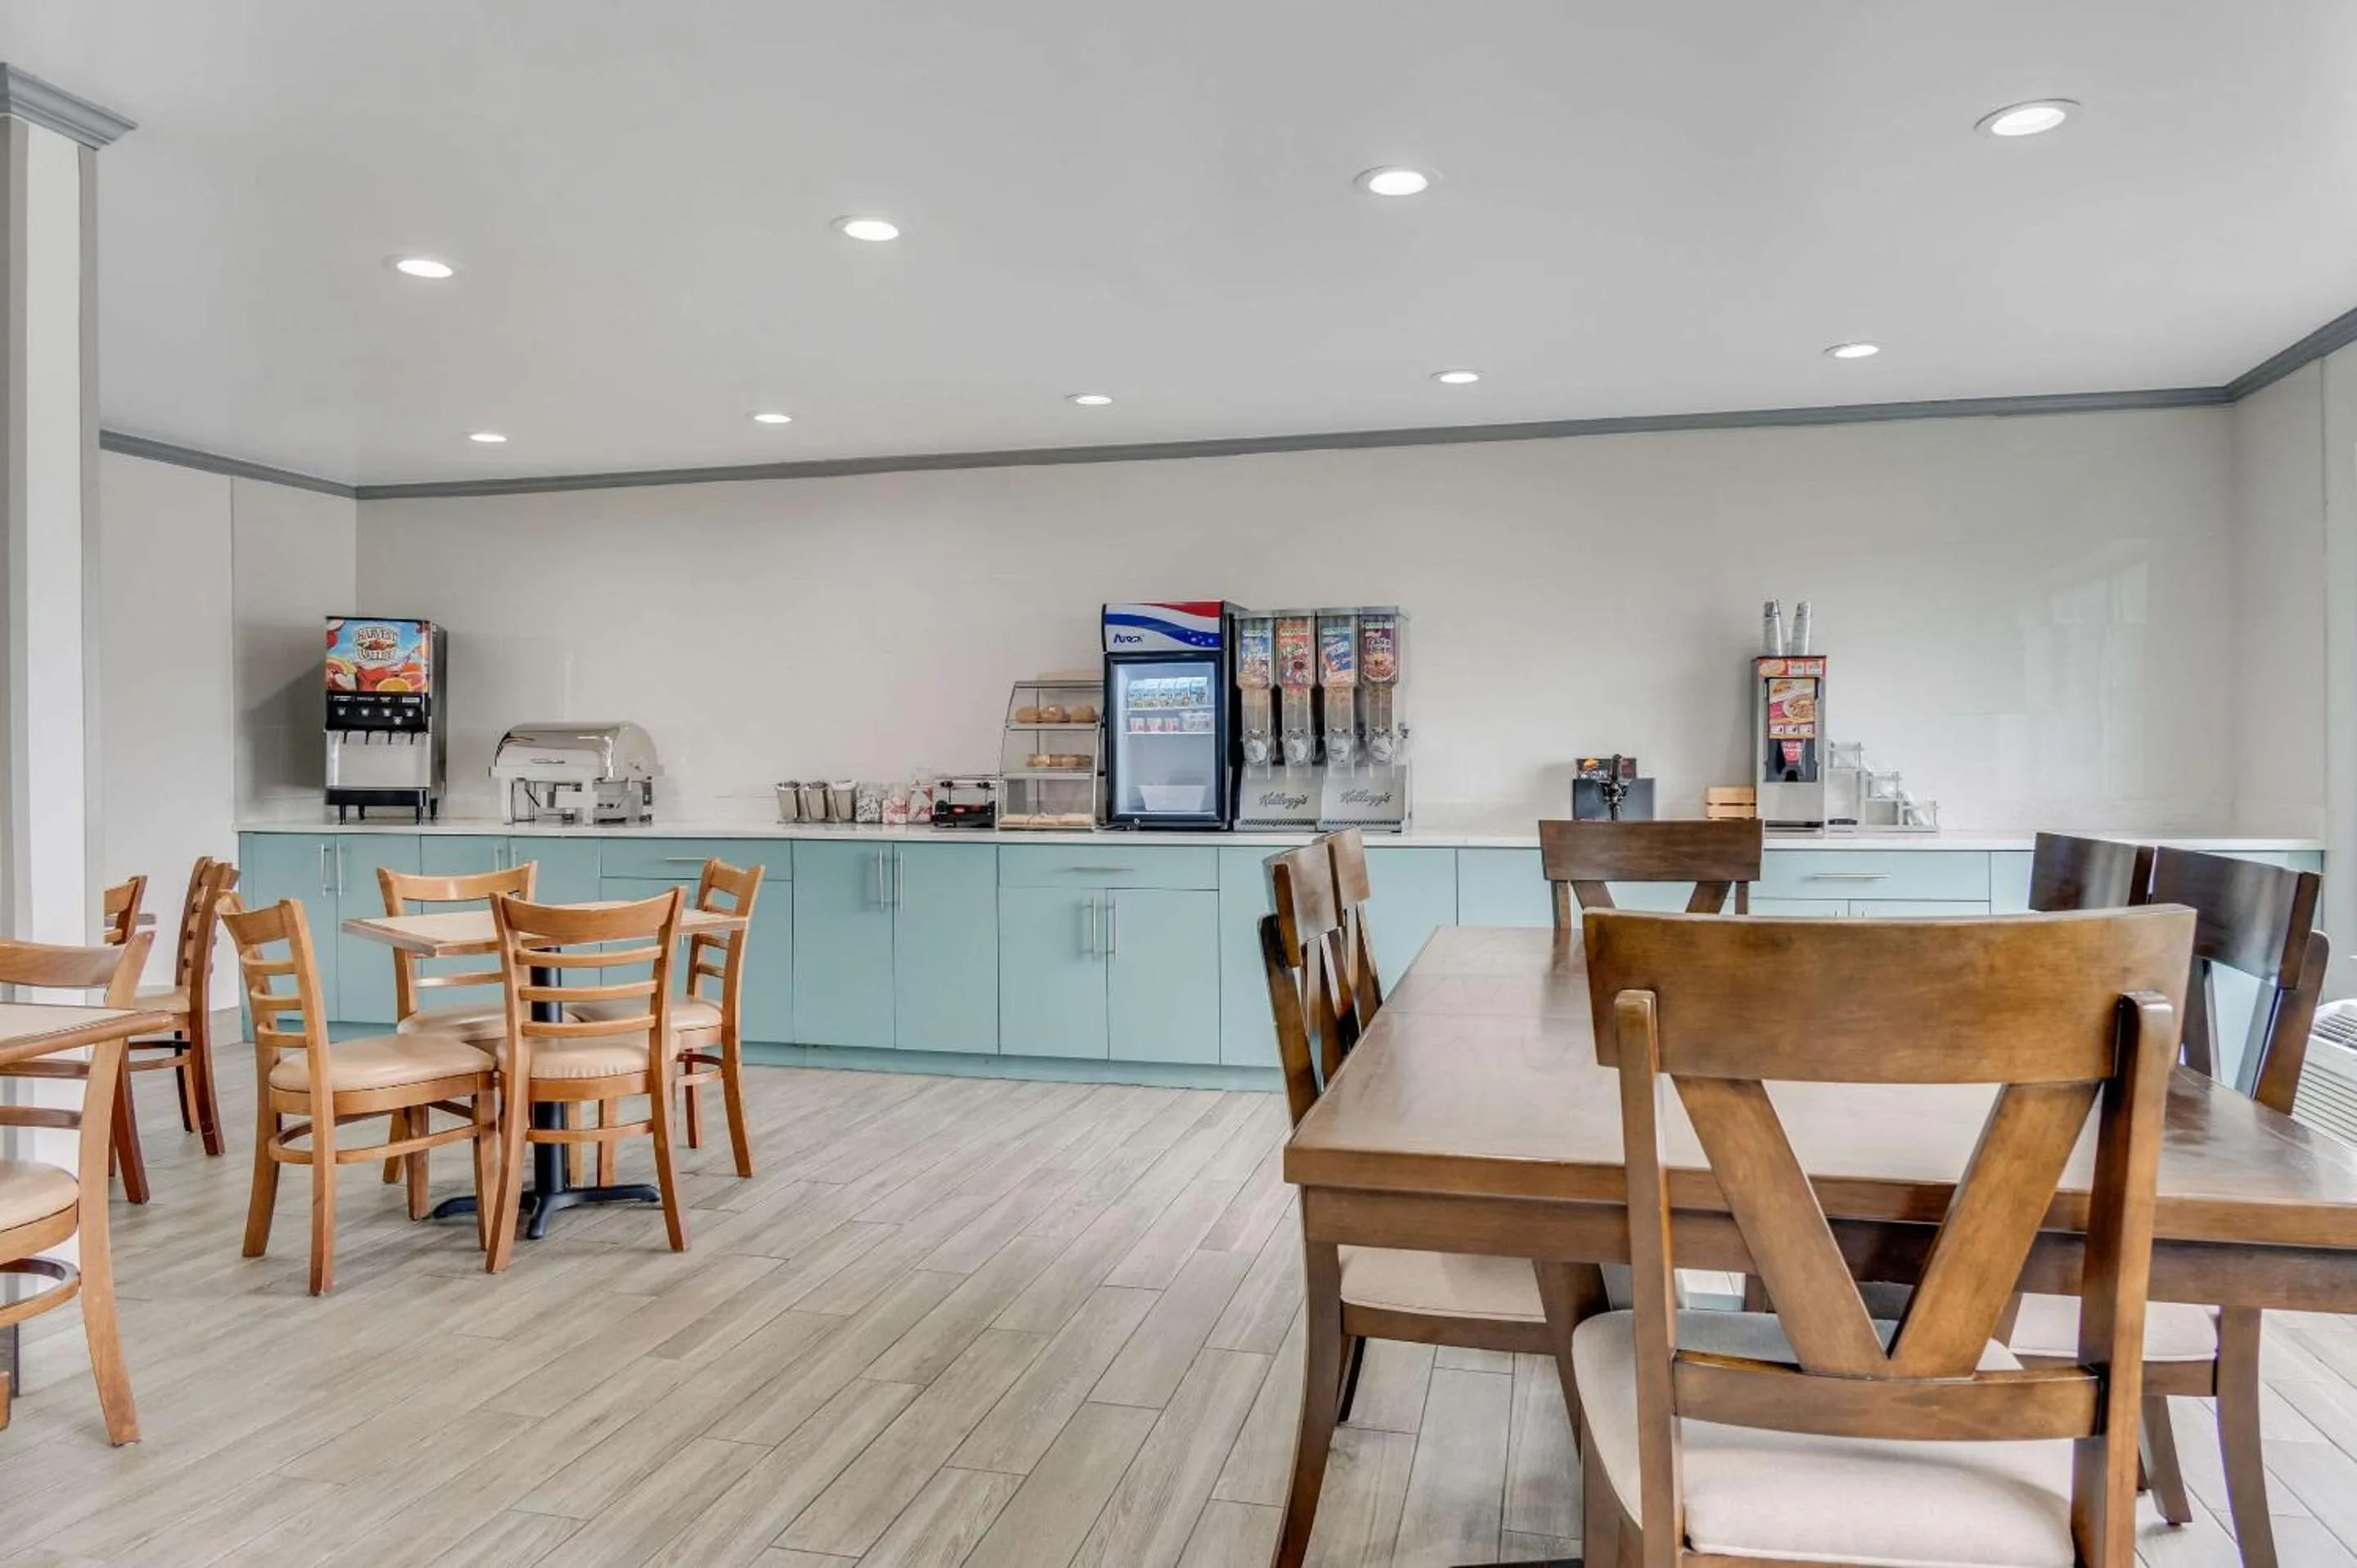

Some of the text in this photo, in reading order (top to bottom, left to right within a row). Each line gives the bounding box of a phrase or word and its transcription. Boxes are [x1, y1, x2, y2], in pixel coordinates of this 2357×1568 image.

[355, 628, 398, 642] HARVEST
[1259, 791, 1309, 809] Kellogg's
[1341, 789, 1392, 807] Kellogg's
